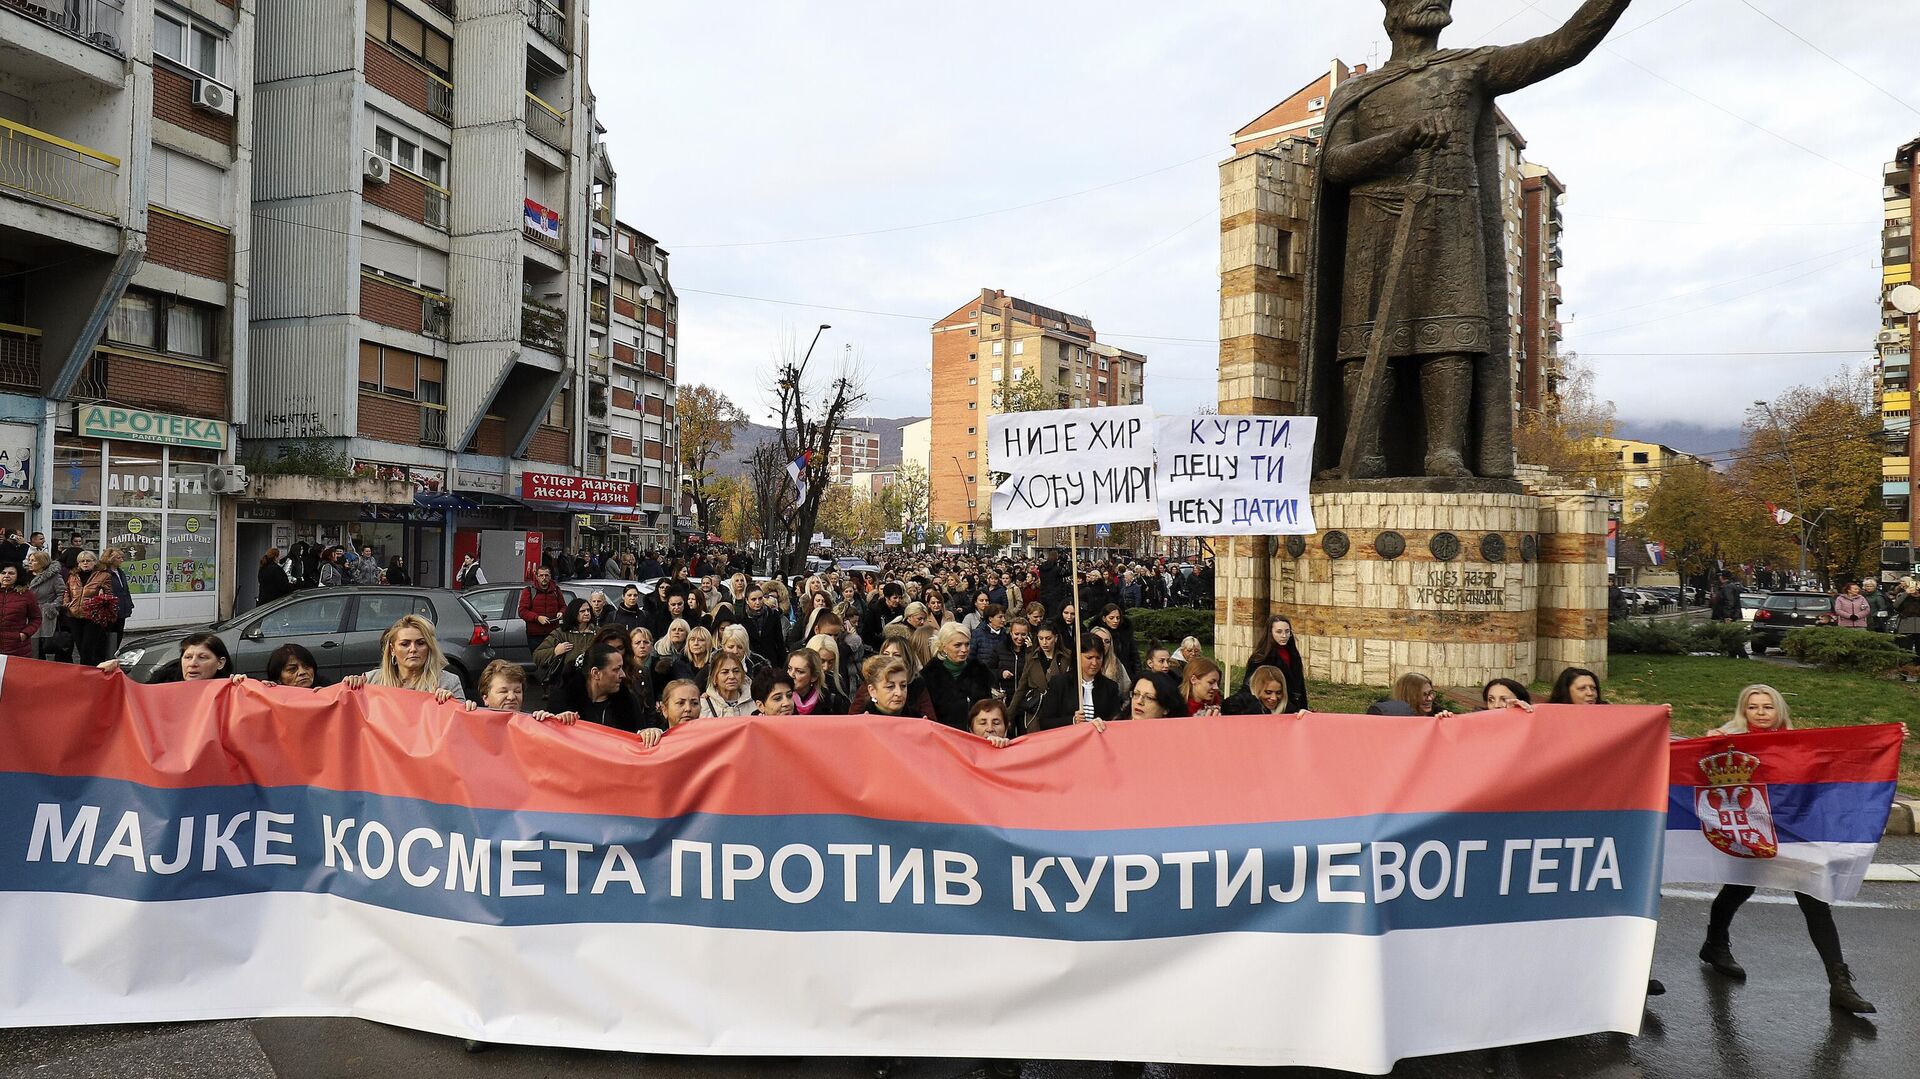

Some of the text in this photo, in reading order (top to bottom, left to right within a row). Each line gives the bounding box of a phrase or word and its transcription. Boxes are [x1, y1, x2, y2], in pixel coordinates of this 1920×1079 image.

[85, 406, 221, 440] APOTEKA
[132, 433, 162, 442] PANTA
[1004, 423, 1077, 458] НИЈЕ
[1088, 418, 1141, 450] ХИР
[1170, 454, 1284, 483] ДЕЦУ ТИ
[108, 473, 203, 495] АПОТЕКА
[532, 474, 630, 493] СУПЕР МАРКЕТ
[1006, 466, 1151, 511] ХОЋУ МИР!
[533, 486, 629, 504] МЕСАРА ЛАЗИЋ
[1169, 498, 1299, 526] НЕЋУ ДАТИ!
[111, 533, 138, 544] ПАНТА
[171, 533, 194, 544] ПАНТА
[129, 562, 205, 572] APOTEKA
[125, 574, 160, 584] PANTA
[1427, 571, 1458, 587] КНЕЗ
[25, 802, 1623, 914] МАЈКЕ КОСМЕТА ПРОТИВ КУРТИЈЕВОГ ГЕТА
